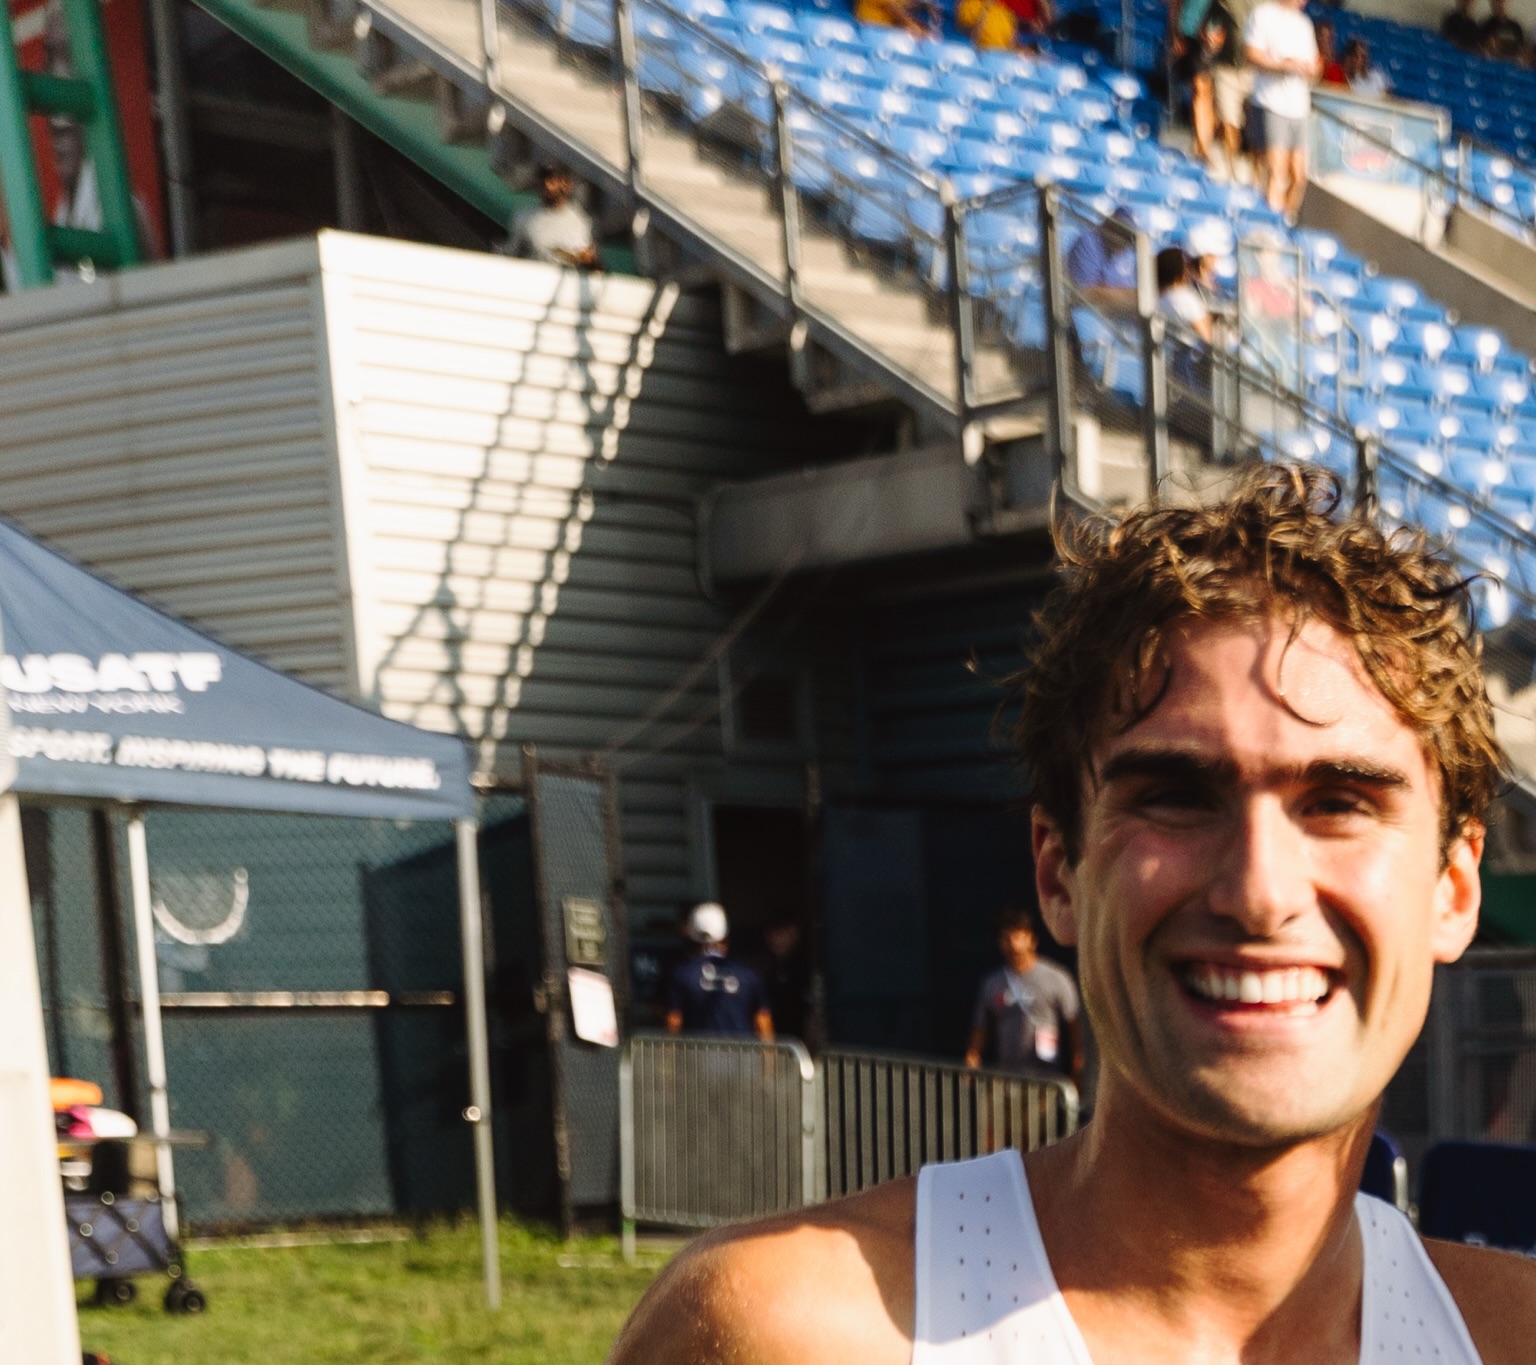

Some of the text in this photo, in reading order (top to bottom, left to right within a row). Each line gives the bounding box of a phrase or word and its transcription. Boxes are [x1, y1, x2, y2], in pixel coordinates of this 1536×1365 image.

[0, 652, 222, 693] USATF
[9, 692, 184, 715] NEW YORK
[267, 747, 327, 783] THE
